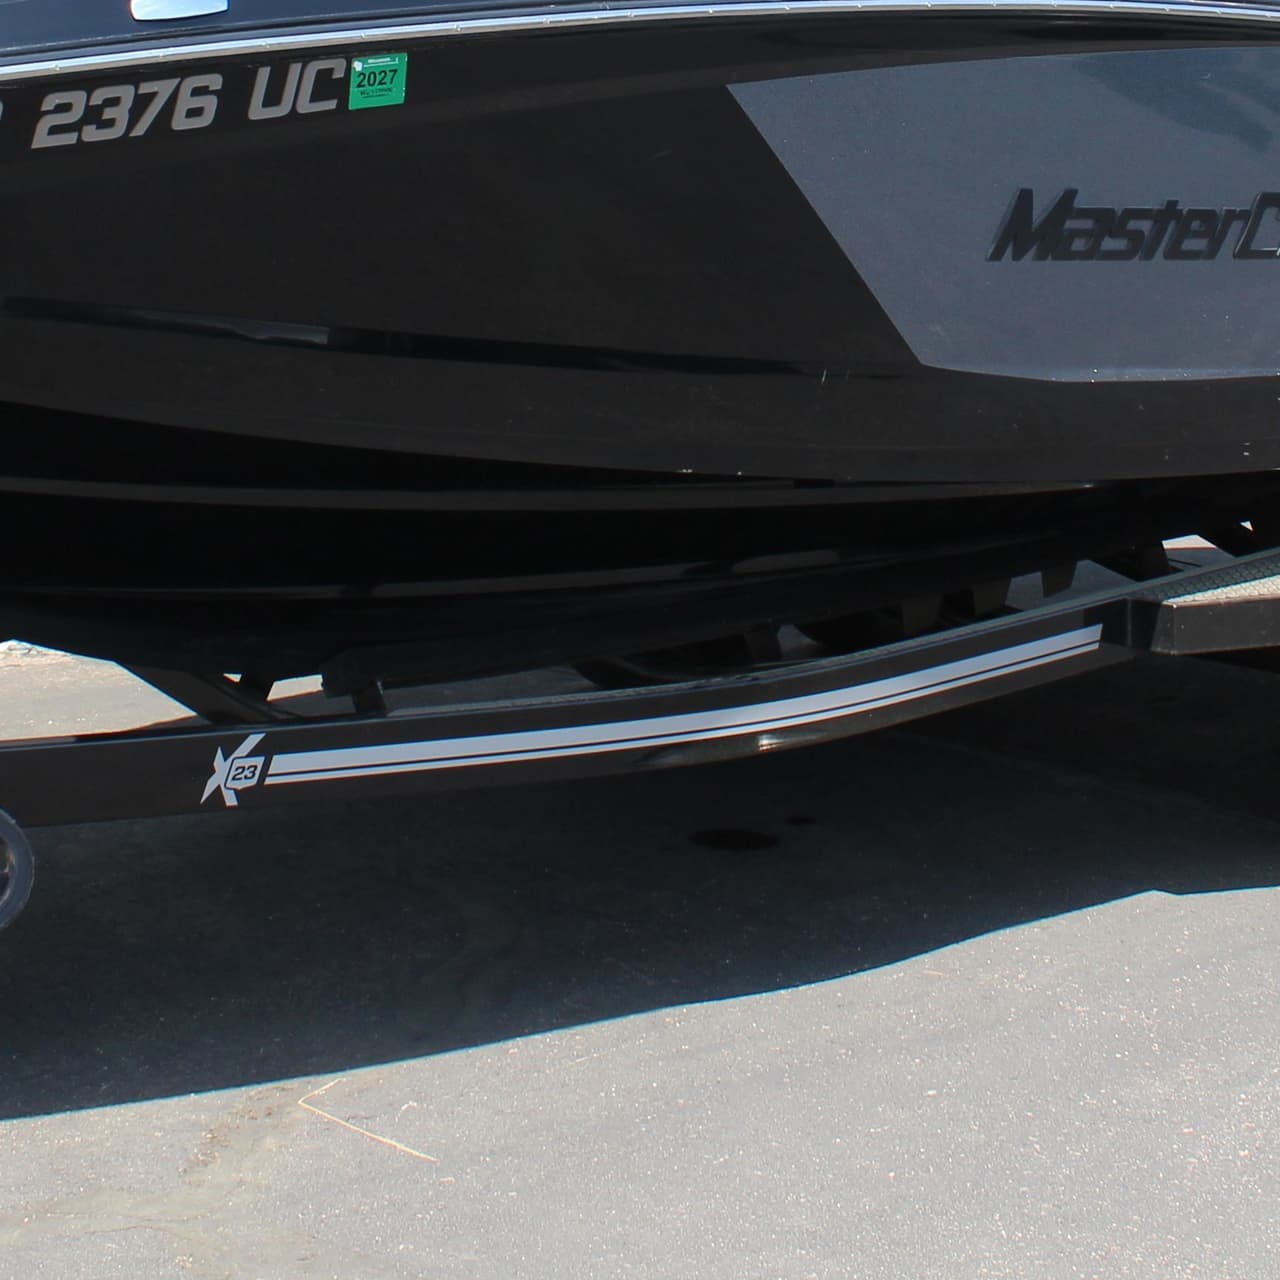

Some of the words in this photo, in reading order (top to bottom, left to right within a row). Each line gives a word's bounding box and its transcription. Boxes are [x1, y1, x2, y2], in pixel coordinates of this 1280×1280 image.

[356, 68, 398, 88] 2027
[30, 73, 223, 149] 2376
[248, 58, 347, 120] UC
[232, 764, 258, 781] 23
